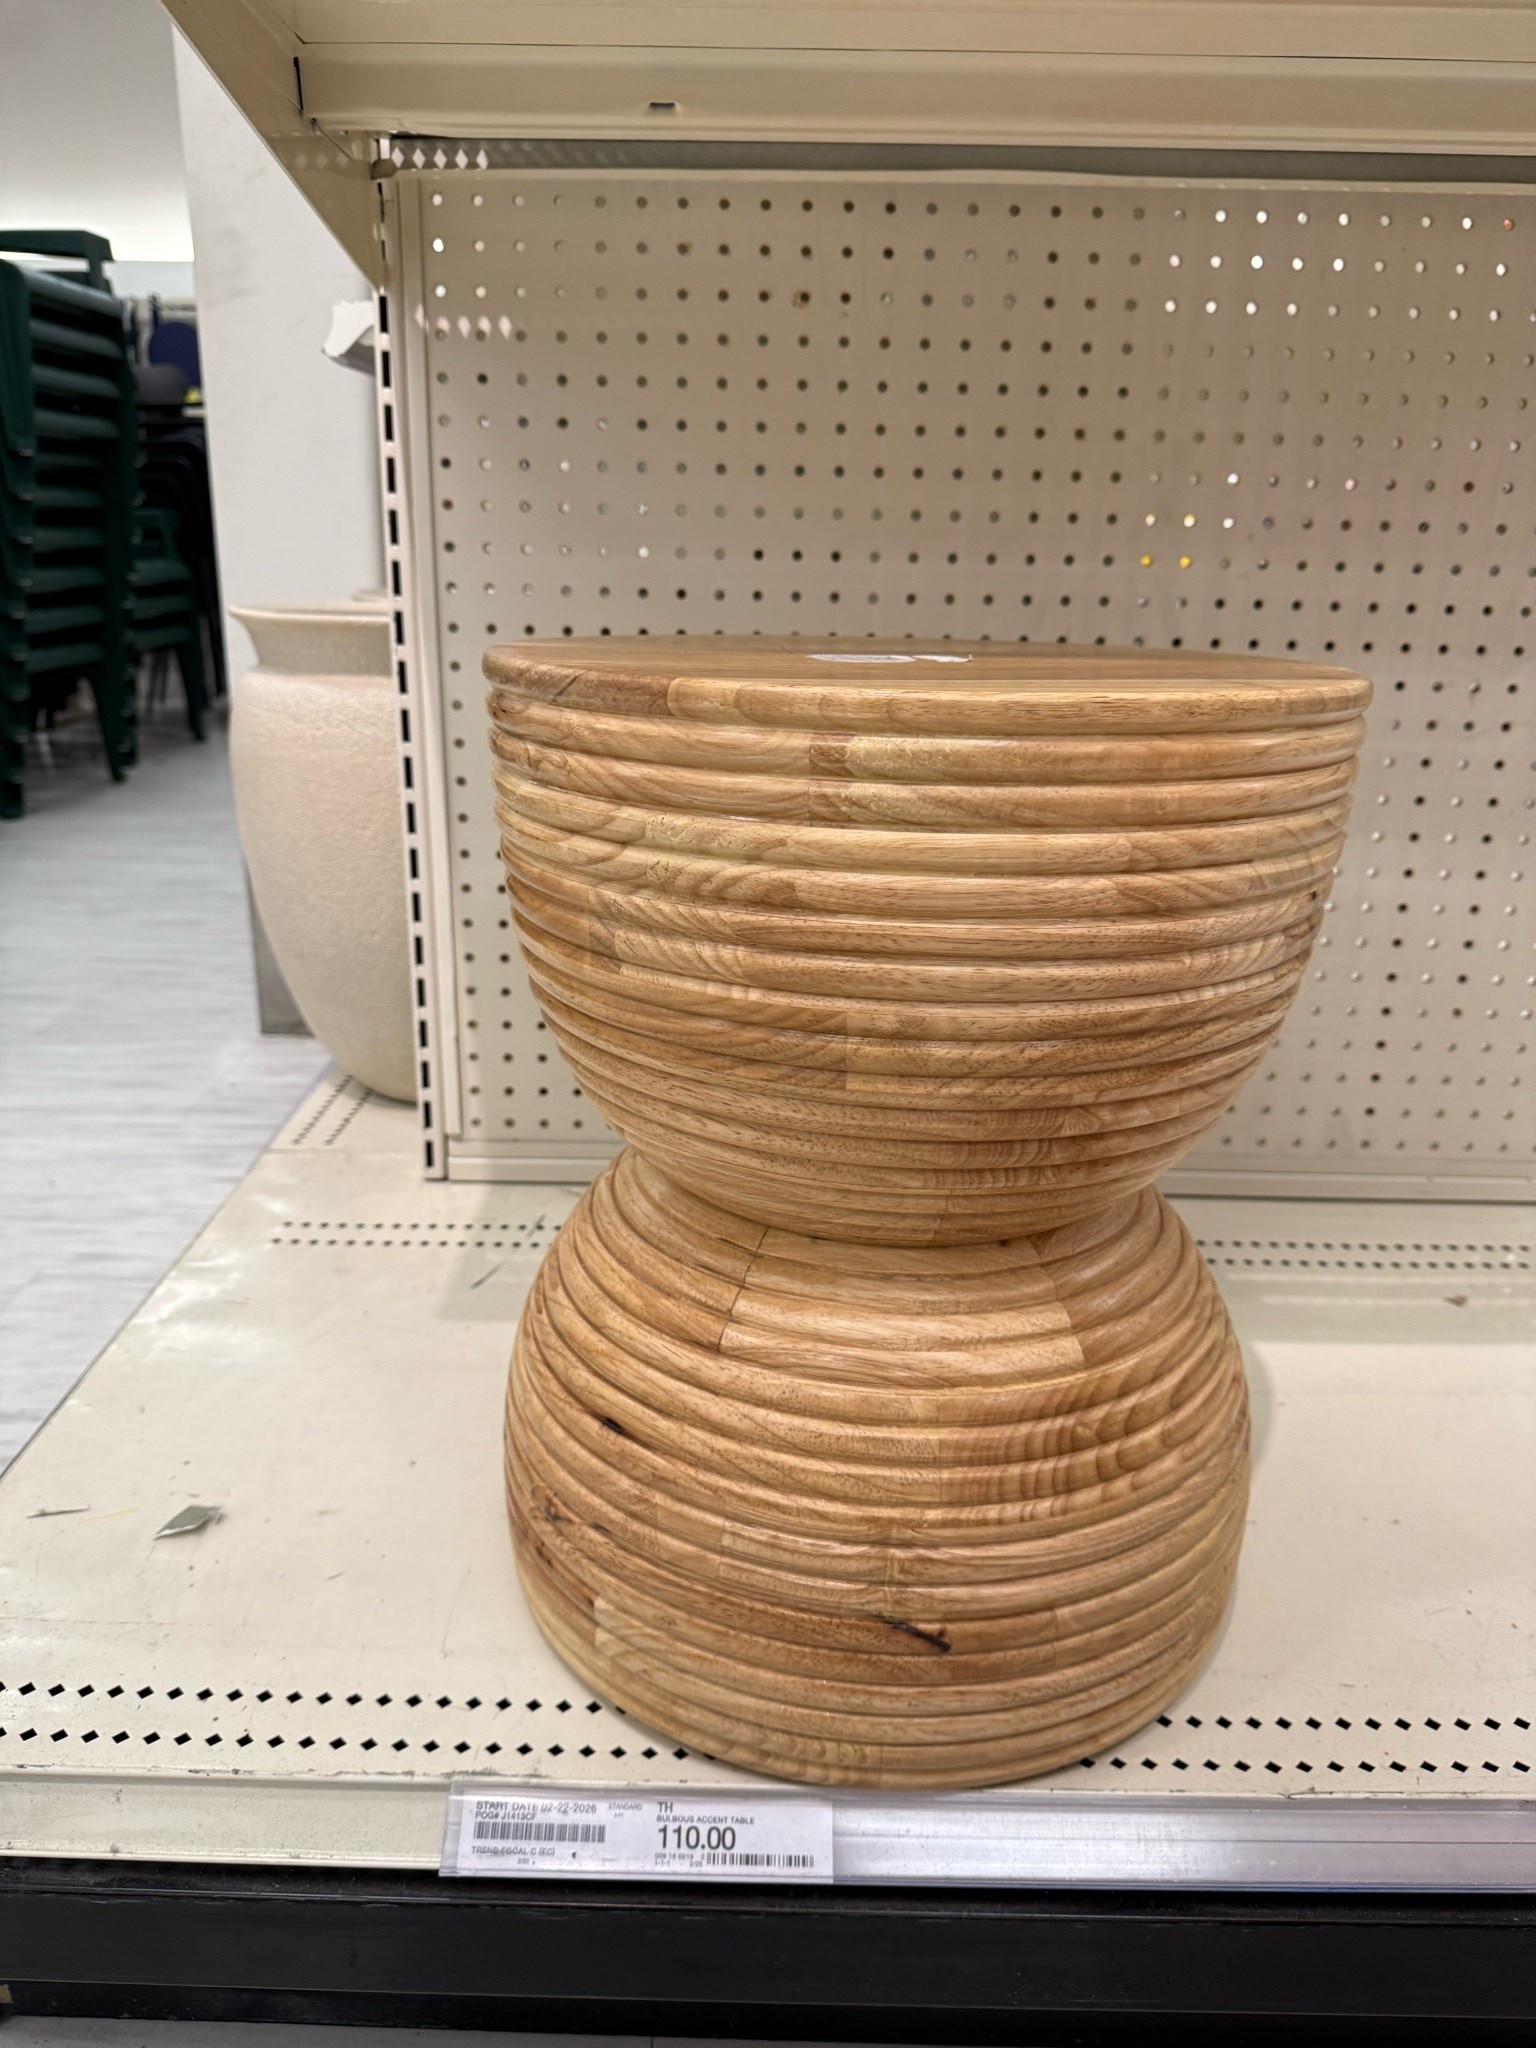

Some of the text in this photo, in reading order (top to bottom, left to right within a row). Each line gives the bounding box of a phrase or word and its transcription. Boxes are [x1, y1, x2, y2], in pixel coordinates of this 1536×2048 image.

[475, 1800, 509, 1811] START
[511, 1801, 538, 1812] DATE
[657, 1801, 674, 1813] TH
[656, 1813, 755, 1826] BULBOUS ACCENT TABLE
[658, 1824, 737, 1851] 110.00
[472, 1845, 500, 1855] TREND
